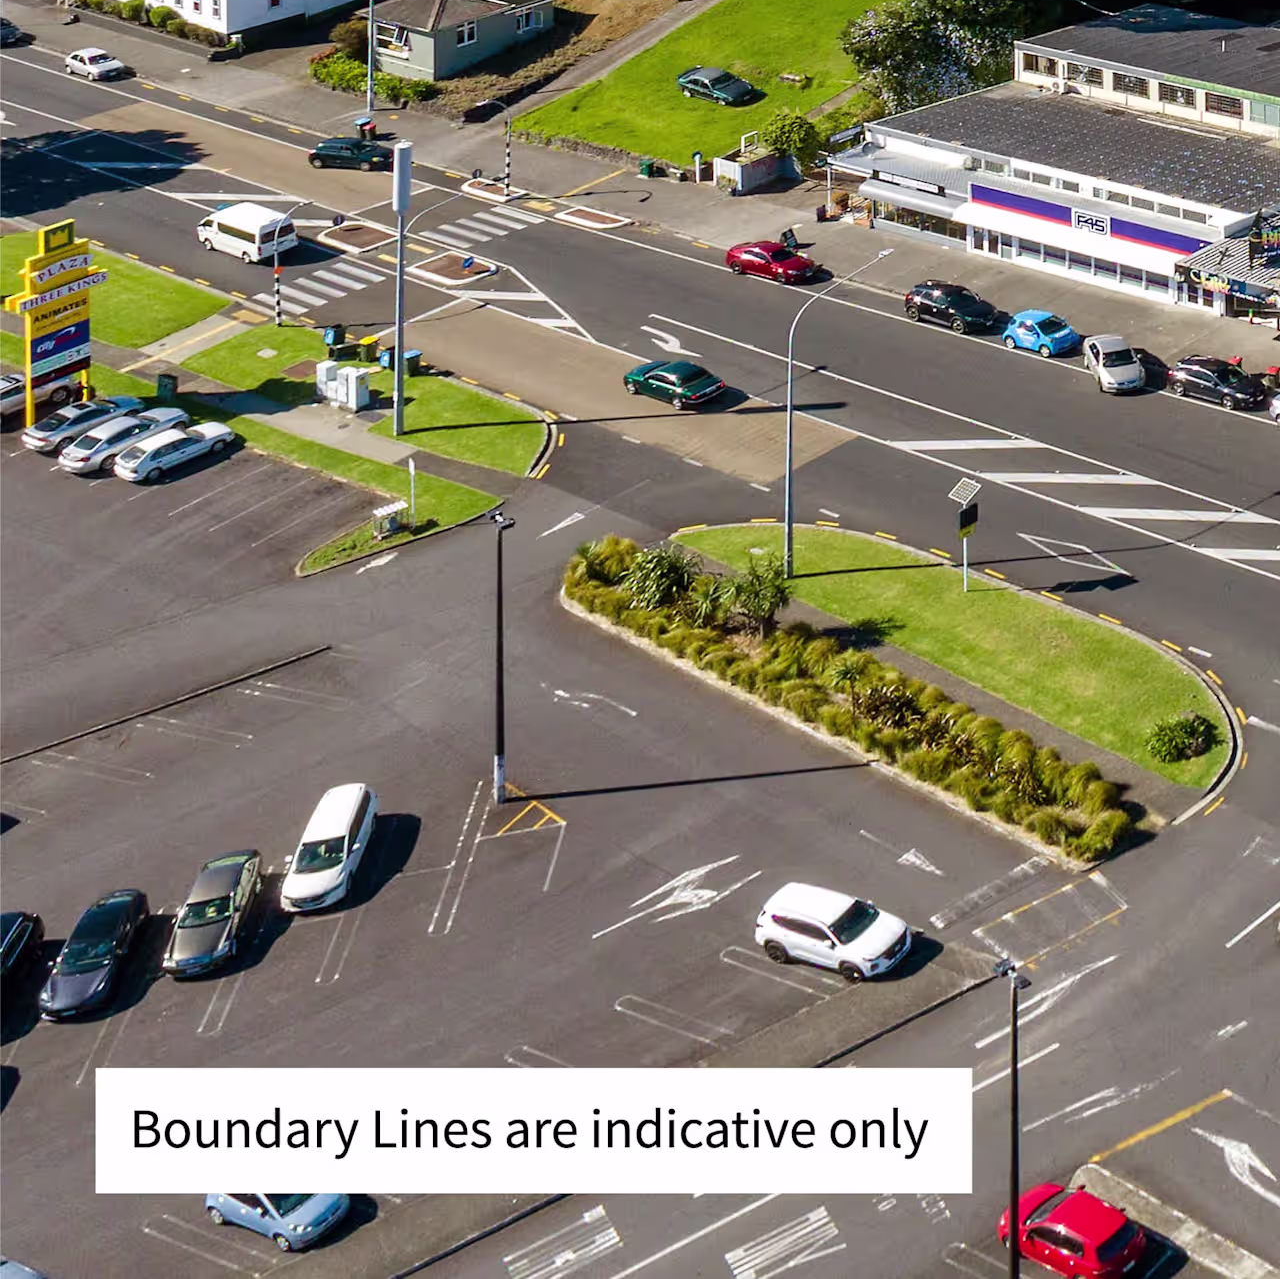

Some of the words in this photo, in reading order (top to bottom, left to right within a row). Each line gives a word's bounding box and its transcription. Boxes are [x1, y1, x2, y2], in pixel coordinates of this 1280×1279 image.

[1078, 214, 1105, 232] F45
[38, 256, 89, 282] PLAZA
[22, 288, 65, 311] THREE
[67, 272, 107, 294] KINGS
[33, 297, 88, 324] ANIMATES
